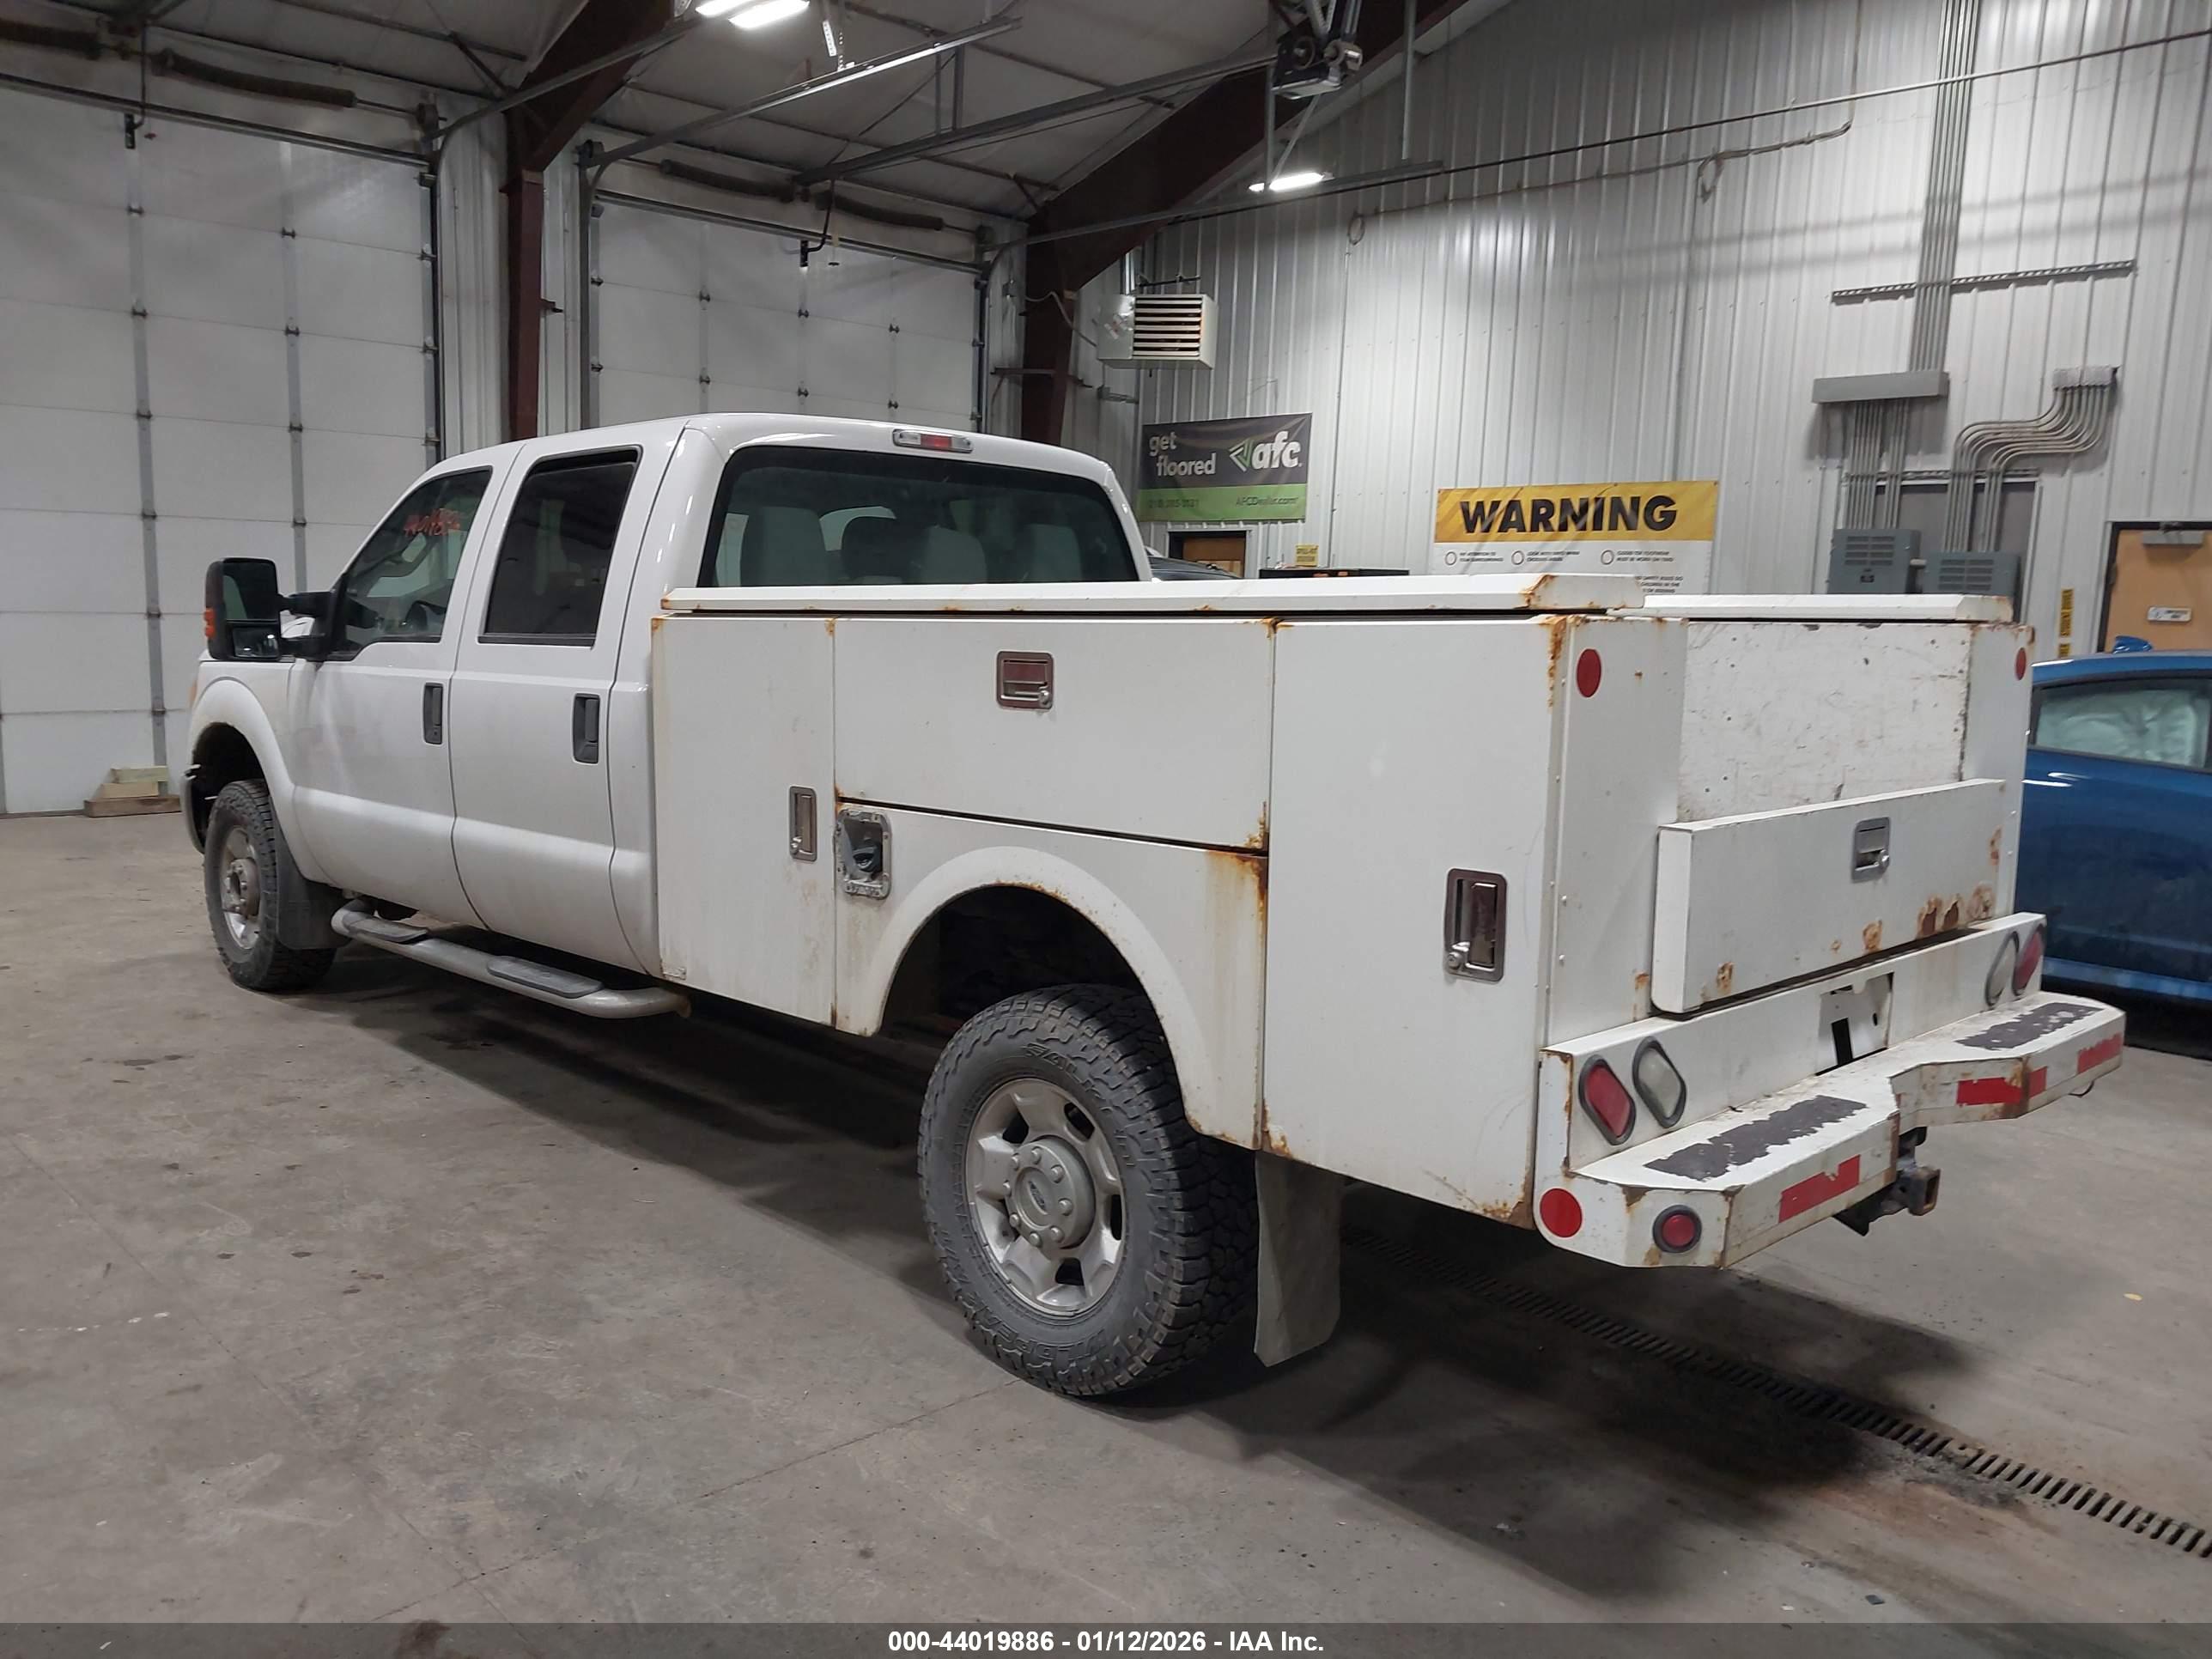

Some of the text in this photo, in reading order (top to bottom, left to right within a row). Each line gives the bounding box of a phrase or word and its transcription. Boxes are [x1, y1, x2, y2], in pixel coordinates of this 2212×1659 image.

[1149, 431, 1176, 456] get
[1157, 453, 1217, 477] floored
[1460, 495, 1677, 533] WARNING
